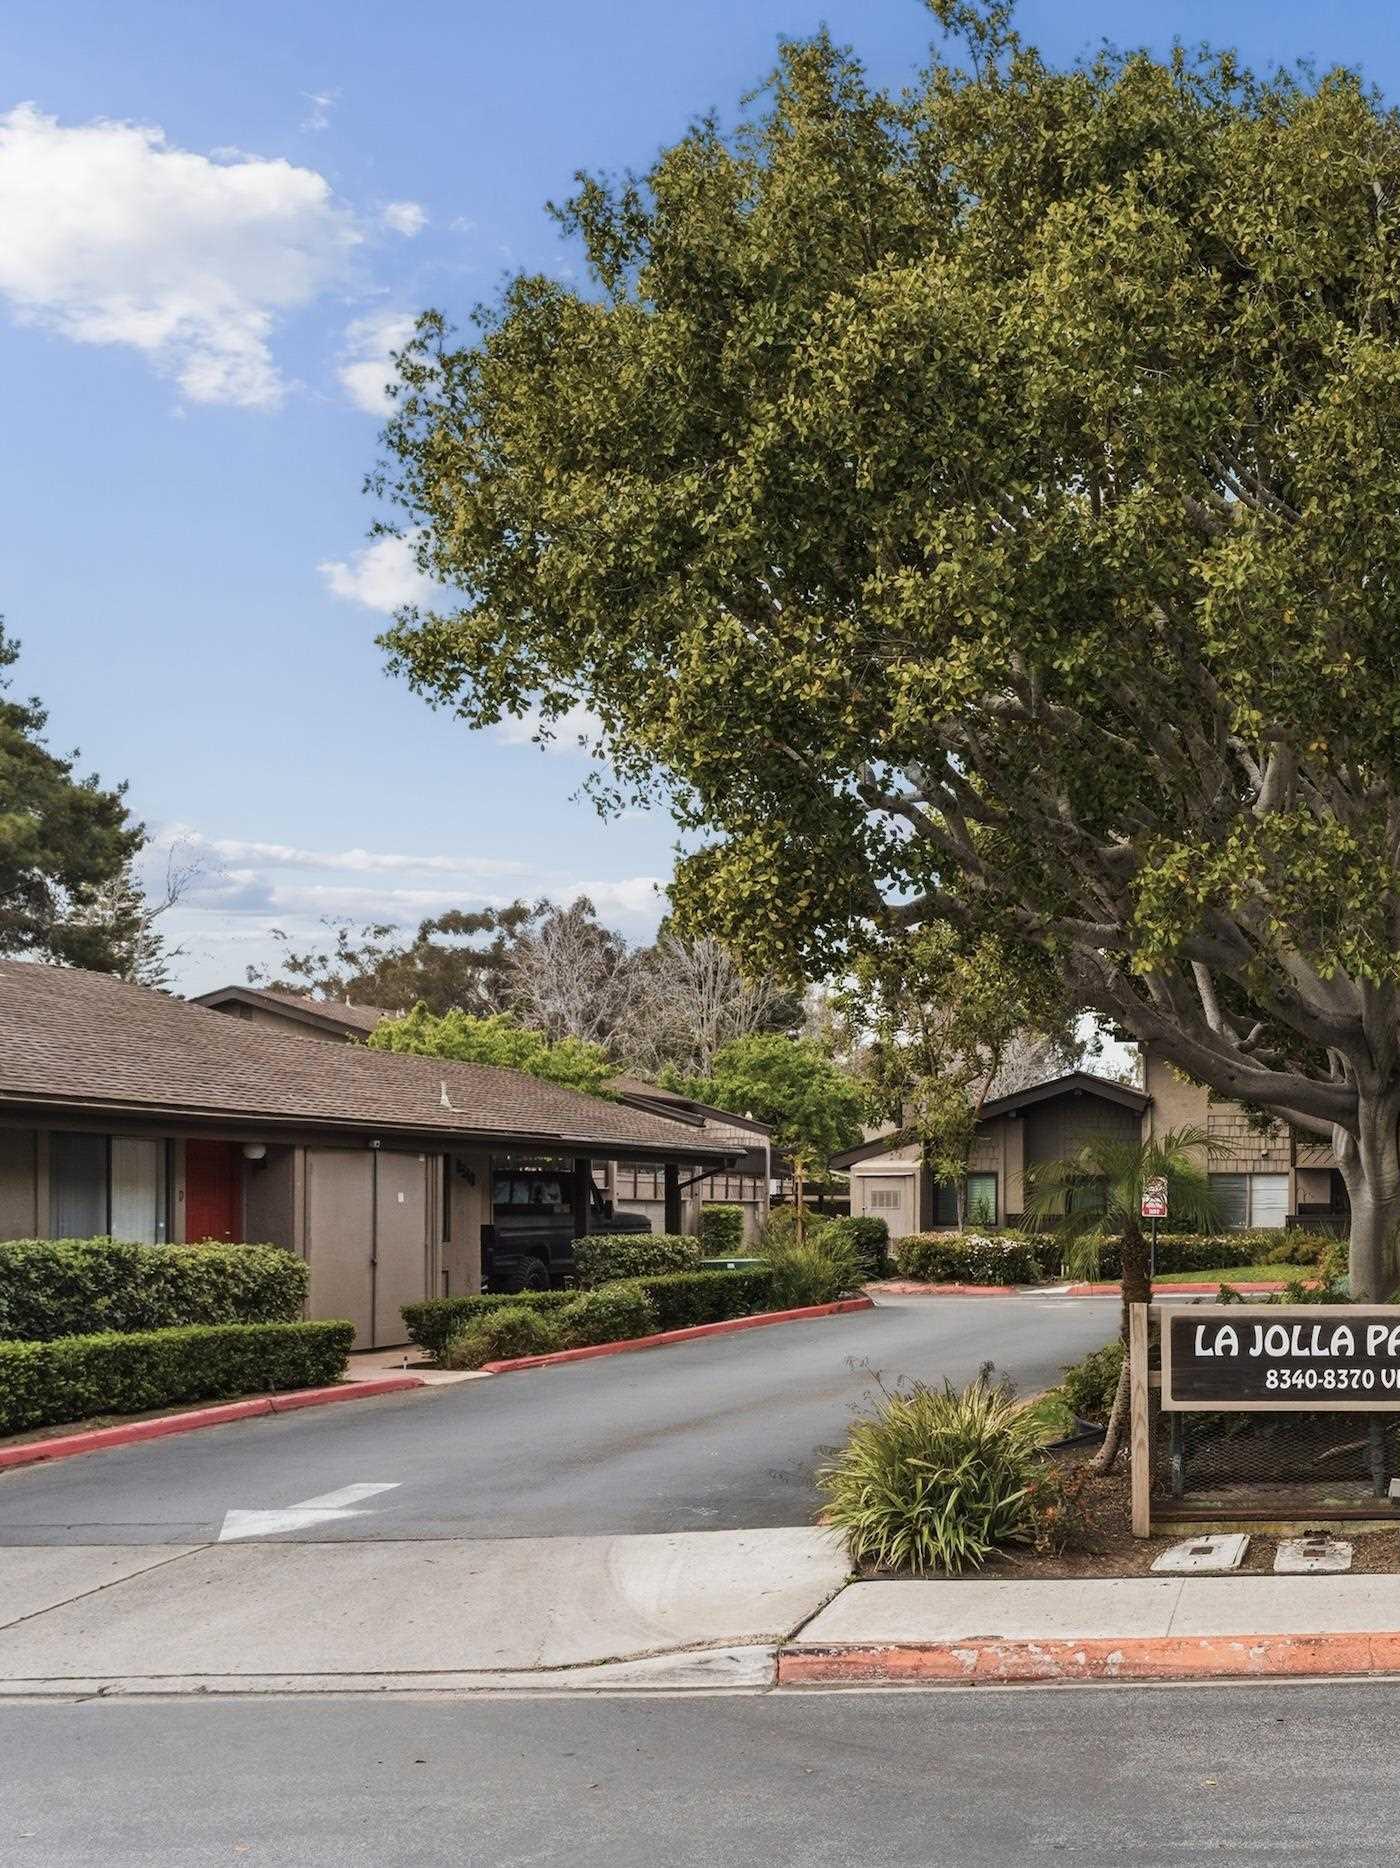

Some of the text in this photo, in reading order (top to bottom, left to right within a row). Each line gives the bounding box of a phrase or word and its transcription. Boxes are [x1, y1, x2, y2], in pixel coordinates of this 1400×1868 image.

[1194, 1324, 1239, 1357] LA
[1248, 1324, 1355, 1357] JOLLA
[1265, 1368, 1375, 1390] 8340-8370
